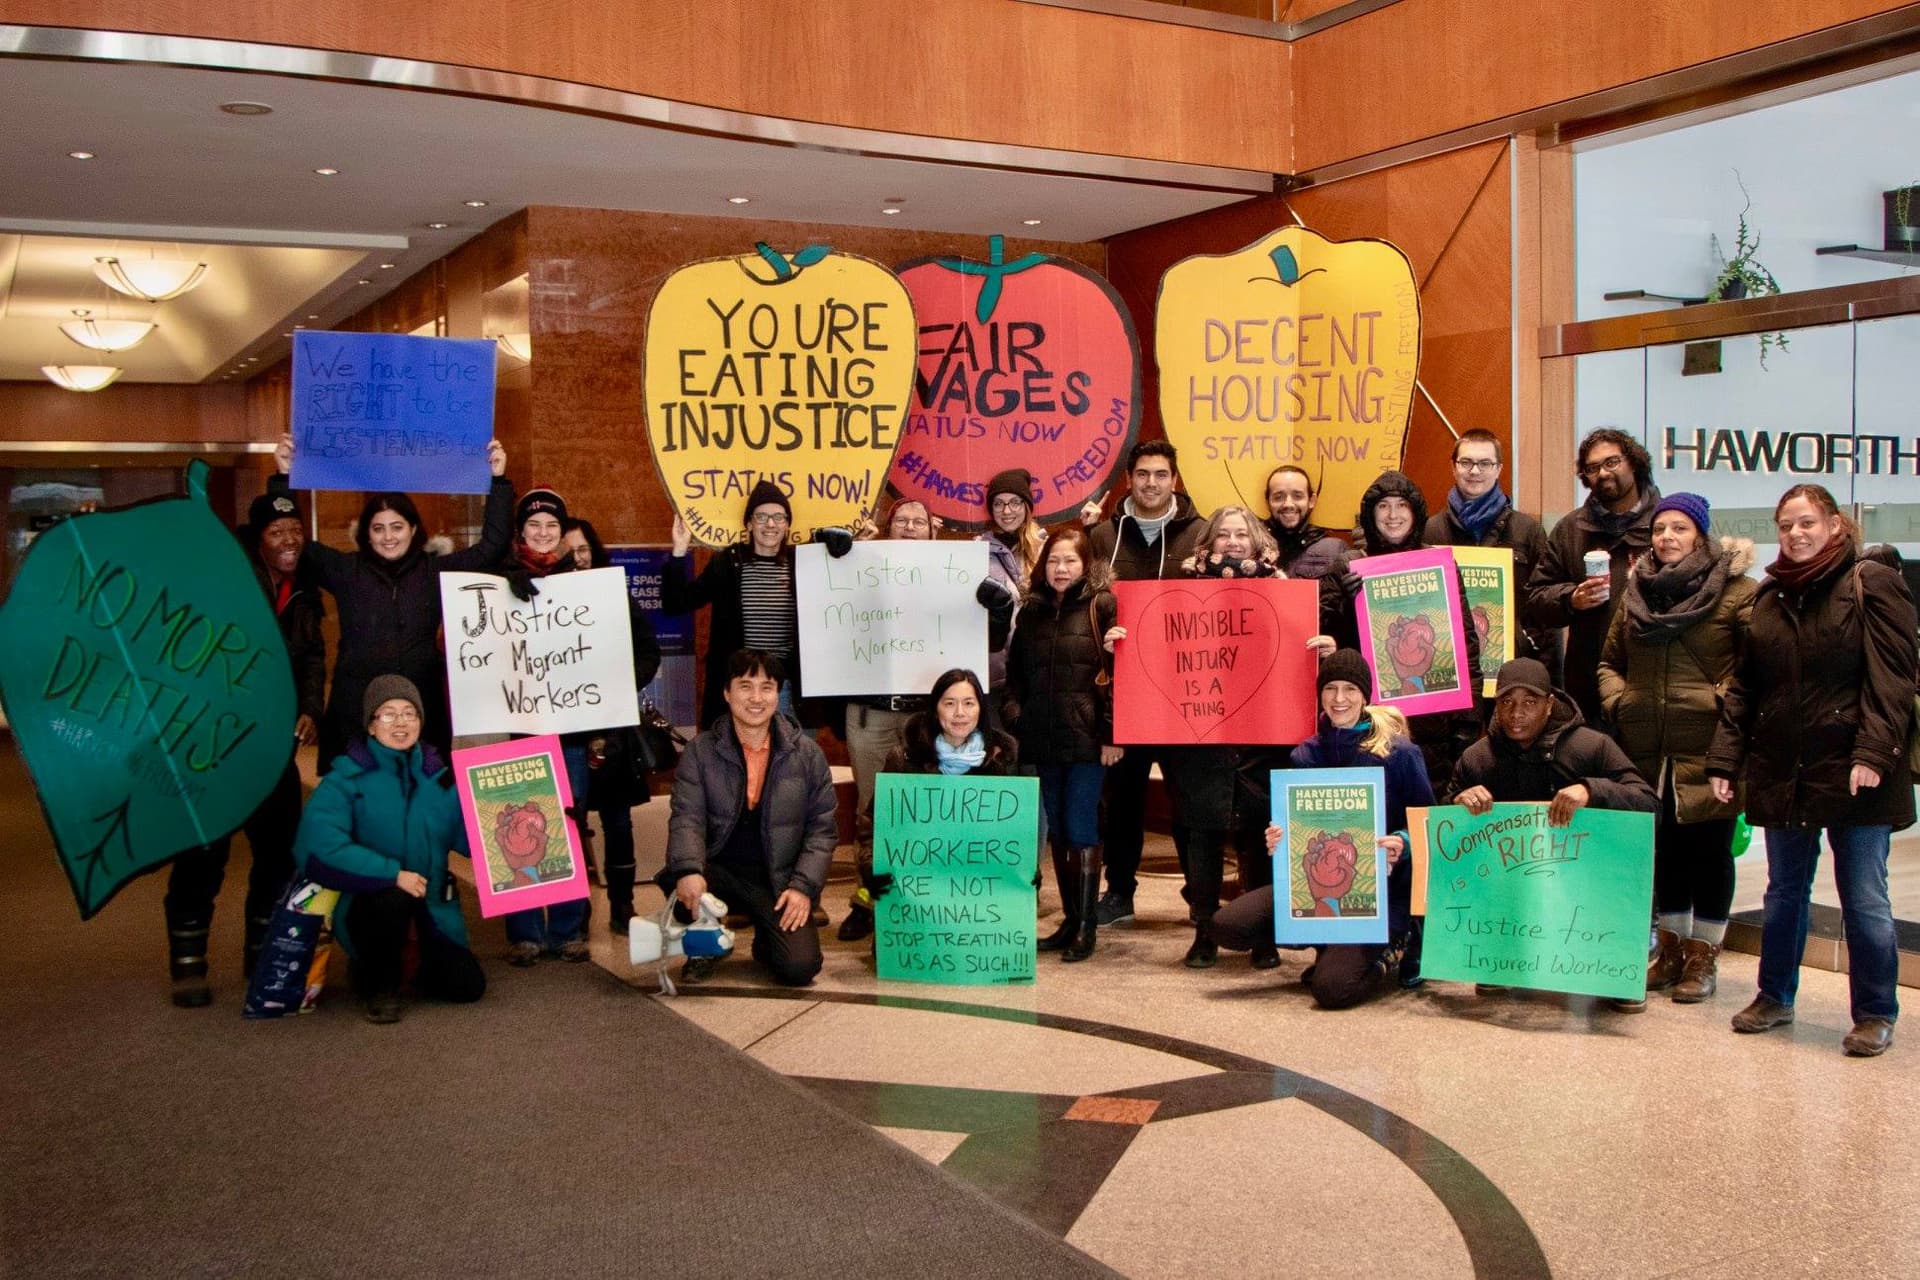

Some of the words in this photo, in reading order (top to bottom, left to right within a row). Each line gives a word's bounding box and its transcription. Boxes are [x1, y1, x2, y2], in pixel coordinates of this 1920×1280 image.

[1205, 311, 1382, 367] DECENT
[305, 340, 355, 379] We
[371, 348, 417, 380] have
[428, 352, 480, 382] the
[679, 349, 875, 399] EATING
[308, 381, 403, 420] RIGHT
[412, 387, 437, 414] to
[447, 390, 472, 414] be
[1189, 367, 1384, 424] HOUSING
[660, 400, 897, 452] INJUSTICE
[906, 414, 986, 440] TATUS
[999, 420, 1066, 443] NOW
[1379, 369, 1412, 472] ARVESTING
[303, 425, 449, 458] LISTENED
[1053, 397, 1129, 496] FREEDOM
[1203, 435, 1305, 462] STATUS
[1317, 436, 1371, 463] NOW
[1664, 426, 1920, 476] HAWORTH
[808, 469, 870, 504] NOW!
[632, 575, 662, 586] SPAC
[825, 552, 922, 591] Listen
[944, 553, 969, 585] to
[1371, 572, 1437, 590] HARVESTING
[1461, 569, 1498, 578] ESTING
[1463, 577, 1498, 588] EDOM
[631, 587, 660, 597] EASE
[1372, 581, 1439, 601] FREEDOM
[59, 553, 136, 629] NO
[131, 586, 274, 696] MORE
[458, 582, 595, 637] Justice
[825, 602, 904, 632] Migrant
[1164, 608, 1254, 643] INVISIBLE
[458, 641, 494, 671] for
[511, 633, 592, 681] Migrant
[853, 637, 925, 664] Workers
[1176, 645, 1239, 674] INJURY
[502, 680, 601, 714] Workers
[1185, 680, 1201, 697] IS
[1209, 677, 1223, 695] A
[43, 634, 258, 773] DEATHS!
[1180, 701, 1226, 720] THING
[476, 758, 545, 779] HARVESTING
[478, 768, 548, 790] FREEDOM
[890, 787, 1019, 828] INJURED
[1296, 788, 1367, 799] HARVESTING
[1296, 798, 1368, 811] FREEDOM
[1437, 806, 1570, 862] Compensati
[884, 838, 1021, 867] WORKERS
[1450, 878, 1466, 892] is
[1477, 863, 1490, 878] a
[1498, 832, 1590, 867] RIGHT
[890, 875, 933, 897] ARE
[951, 876, 1002, 897] NOT
[889, 904, 1001, 924] CRIMINALS
[1445, 906, 1546, 939] Justice
[1559, 904, 1616, 945] for
[884, 930, 925, 948] STOP
[929, 930, 1027, 948] TREATING
[898, 954, 925, 970] US
[929, 954, 956, 972] AS
[966, 953, 1029, 974] SUCH!!!
[1464, 944, 1540, 974] Injured
